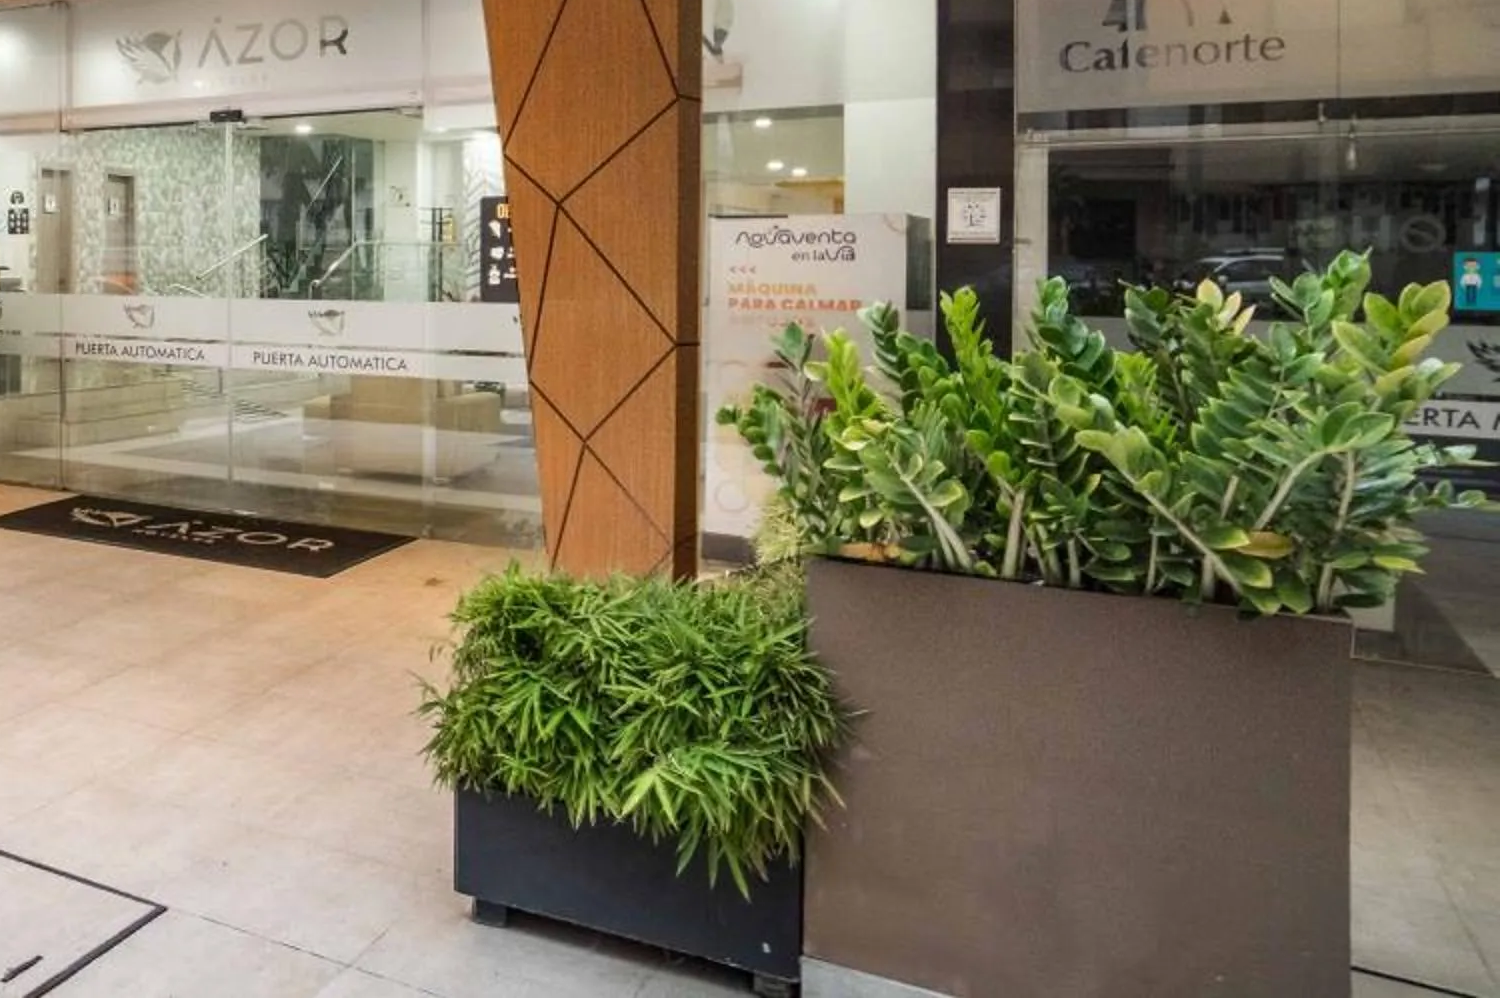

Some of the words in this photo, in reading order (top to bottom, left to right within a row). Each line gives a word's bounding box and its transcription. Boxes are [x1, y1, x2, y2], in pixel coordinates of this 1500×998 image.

[728, 298, 776, 310] PARA
[75, 342, 118, 357] PUERTA
[120, 345, 205, 361] AUTOMATICA
[253, 351, 304, 367] PUERTA
[307, 353, 407, 372] AUTOMATICA
